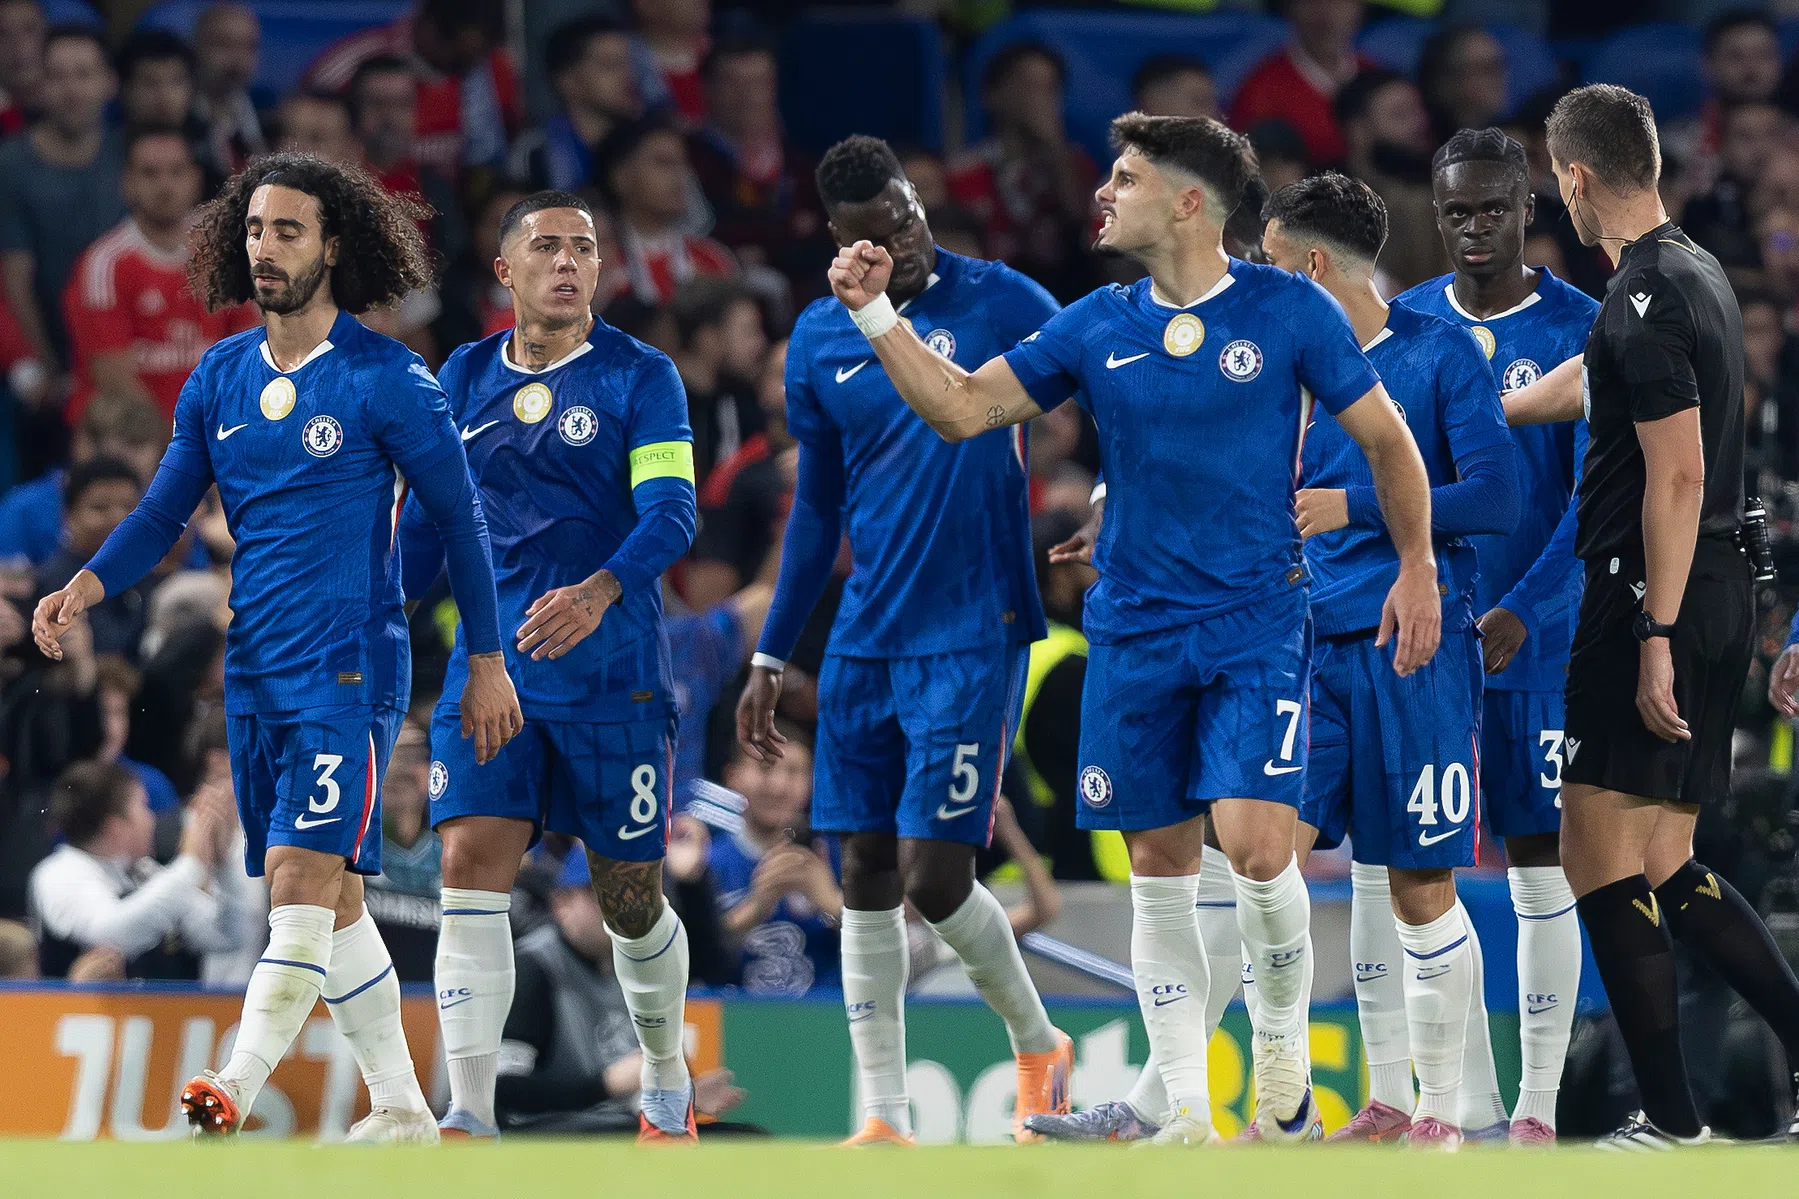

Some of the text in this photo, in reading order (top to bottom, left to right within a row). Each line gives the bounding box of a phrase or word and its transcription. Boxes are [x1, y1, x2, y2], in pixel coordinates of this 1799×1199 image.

[1276, 699, 1301, 761] 7
[309, 754, 343, 814] 3
[630, 764, 657, 824] 8
[948, 742, 979, 803] 5
[1407, 762, 1470, 825] 40
[439, 987, 471, 999] CFC
[1152, 984, 1187, 995] CFC
[1356, 963, 1387, 972] CFC
[1527, 993, 1558, 1004] CFC
